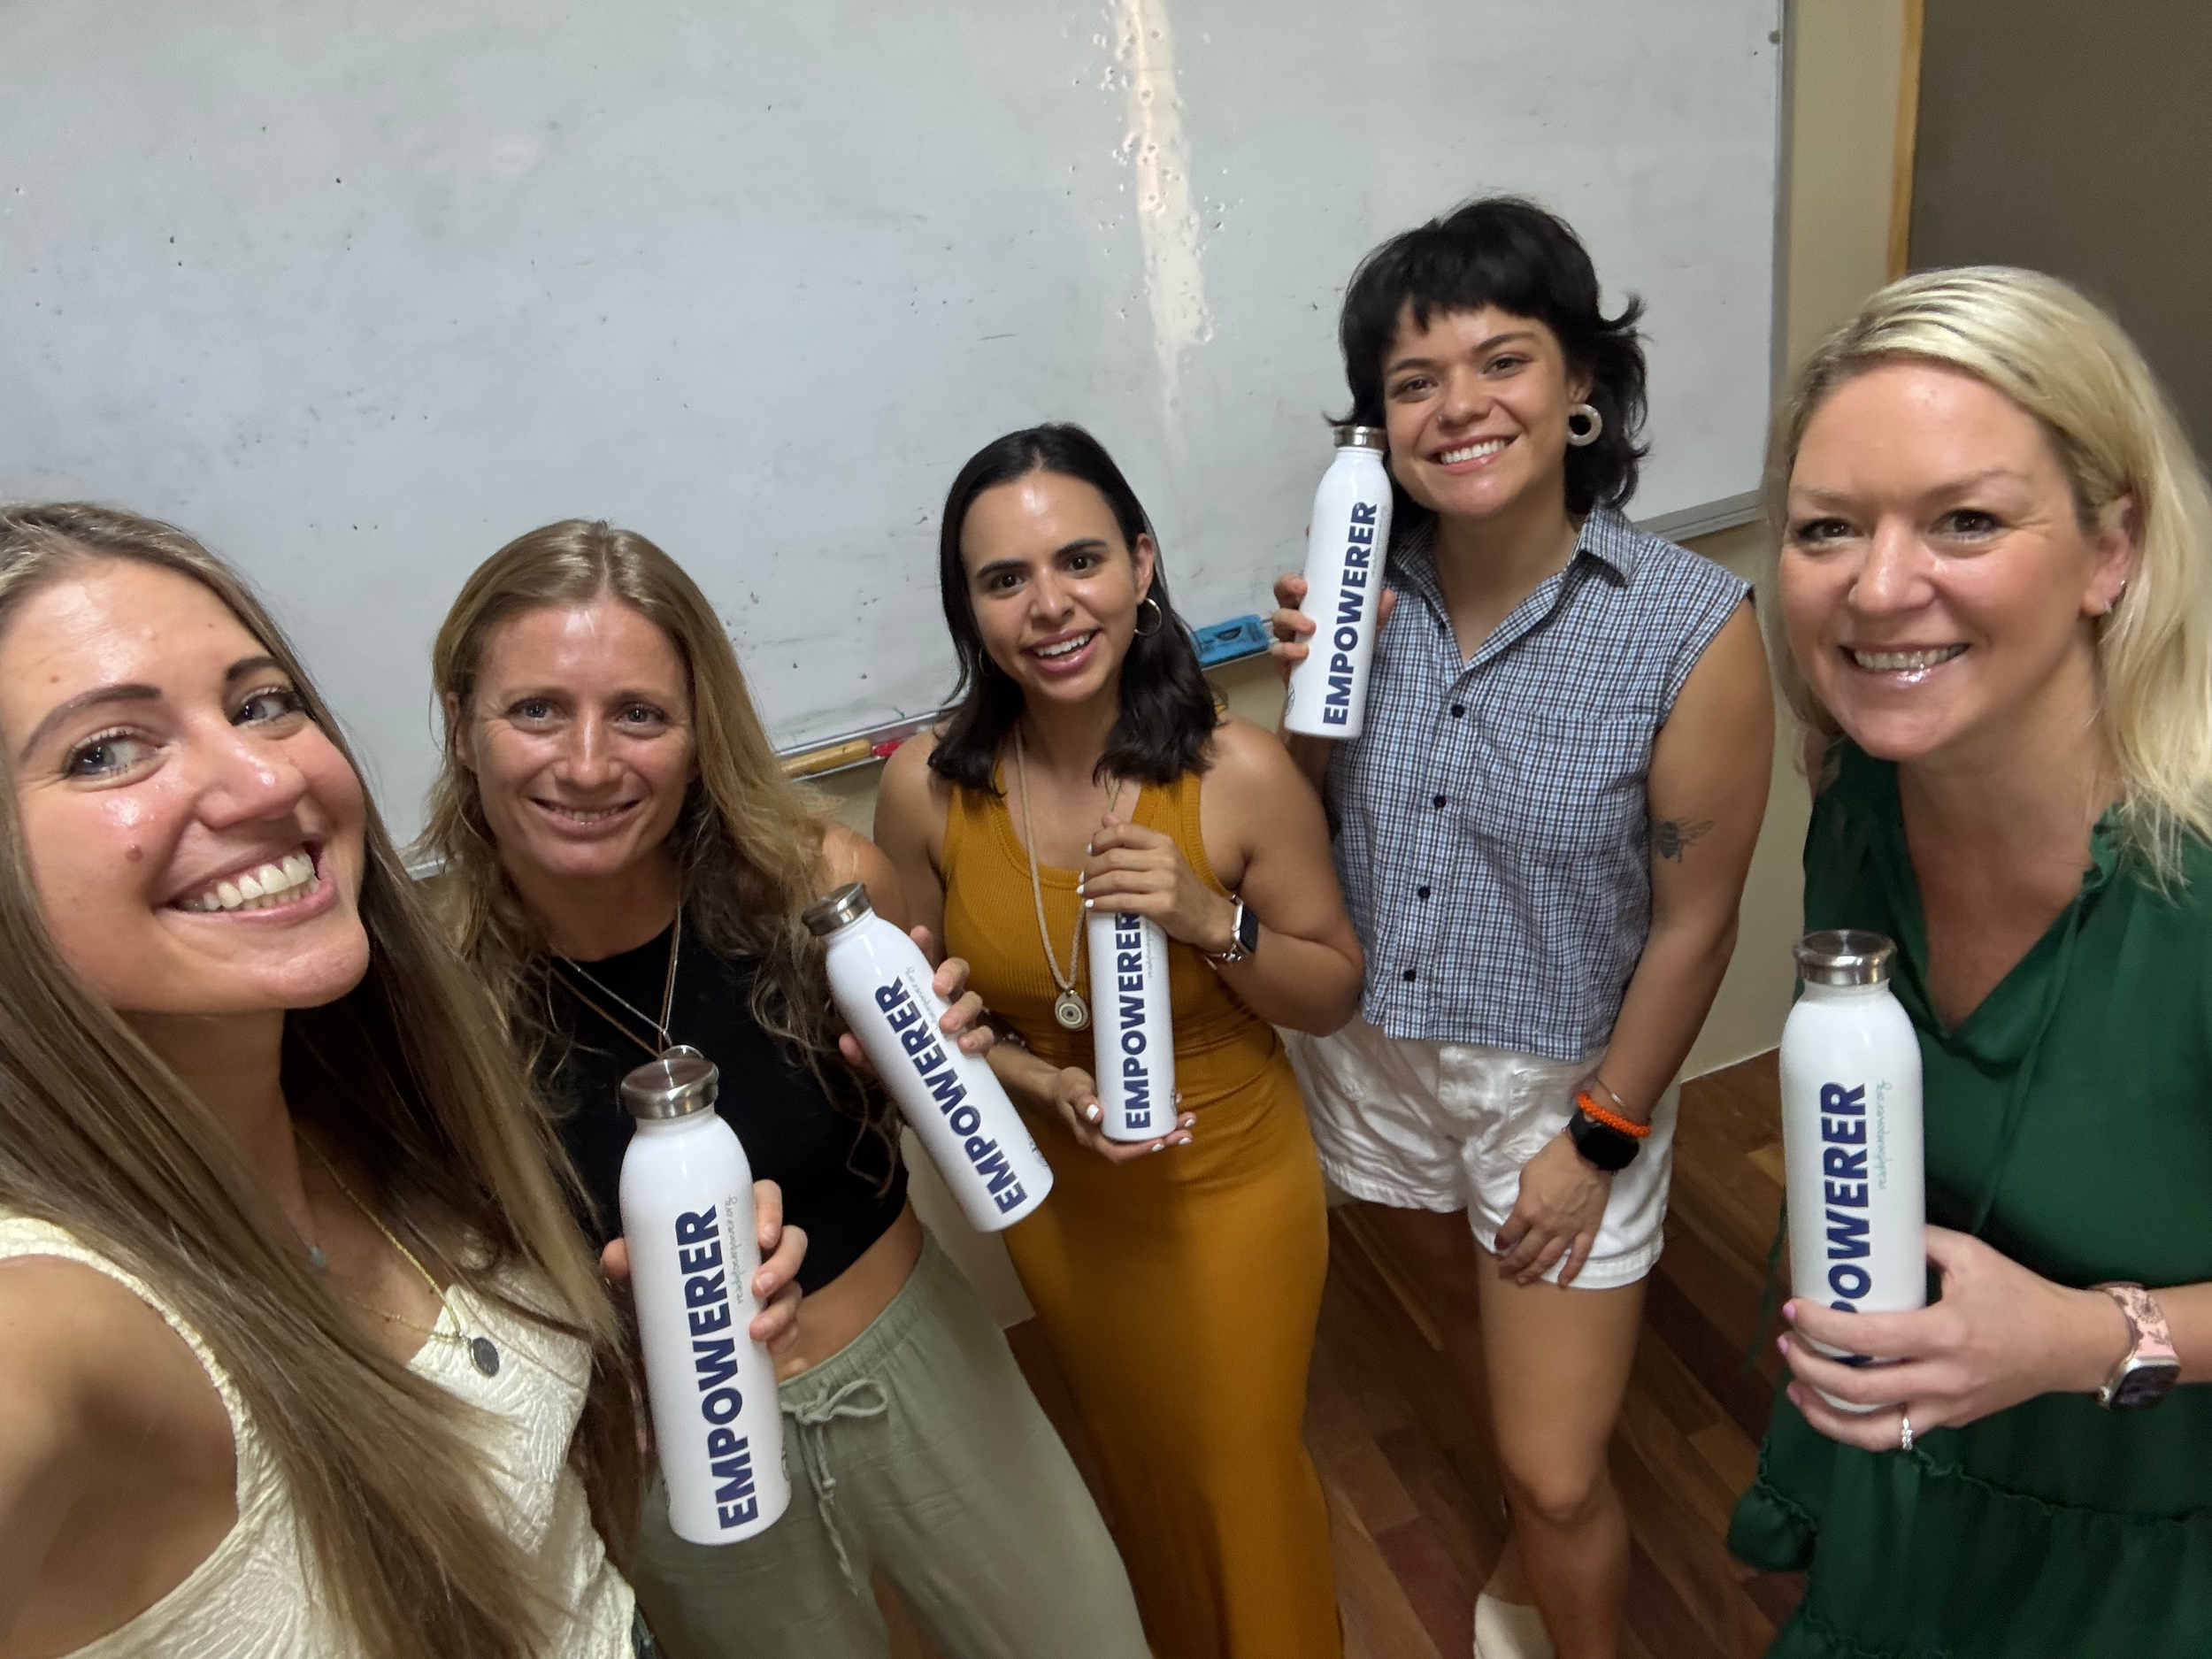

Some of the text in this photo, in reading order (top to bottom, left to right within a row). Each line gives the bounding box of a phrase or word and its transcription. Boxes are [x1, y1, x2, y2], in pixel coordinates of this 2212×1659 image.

[1323, 501, 1378, 726] EMPOWERER
[874, 976, 1028, 1215] EMPOWERER
[1115, 912, 1152, 1129] EMPOWERER
[1820, 1081, 1872, 1314] OWERER
[675, 1204, 759, 1530] EMPOWERER
